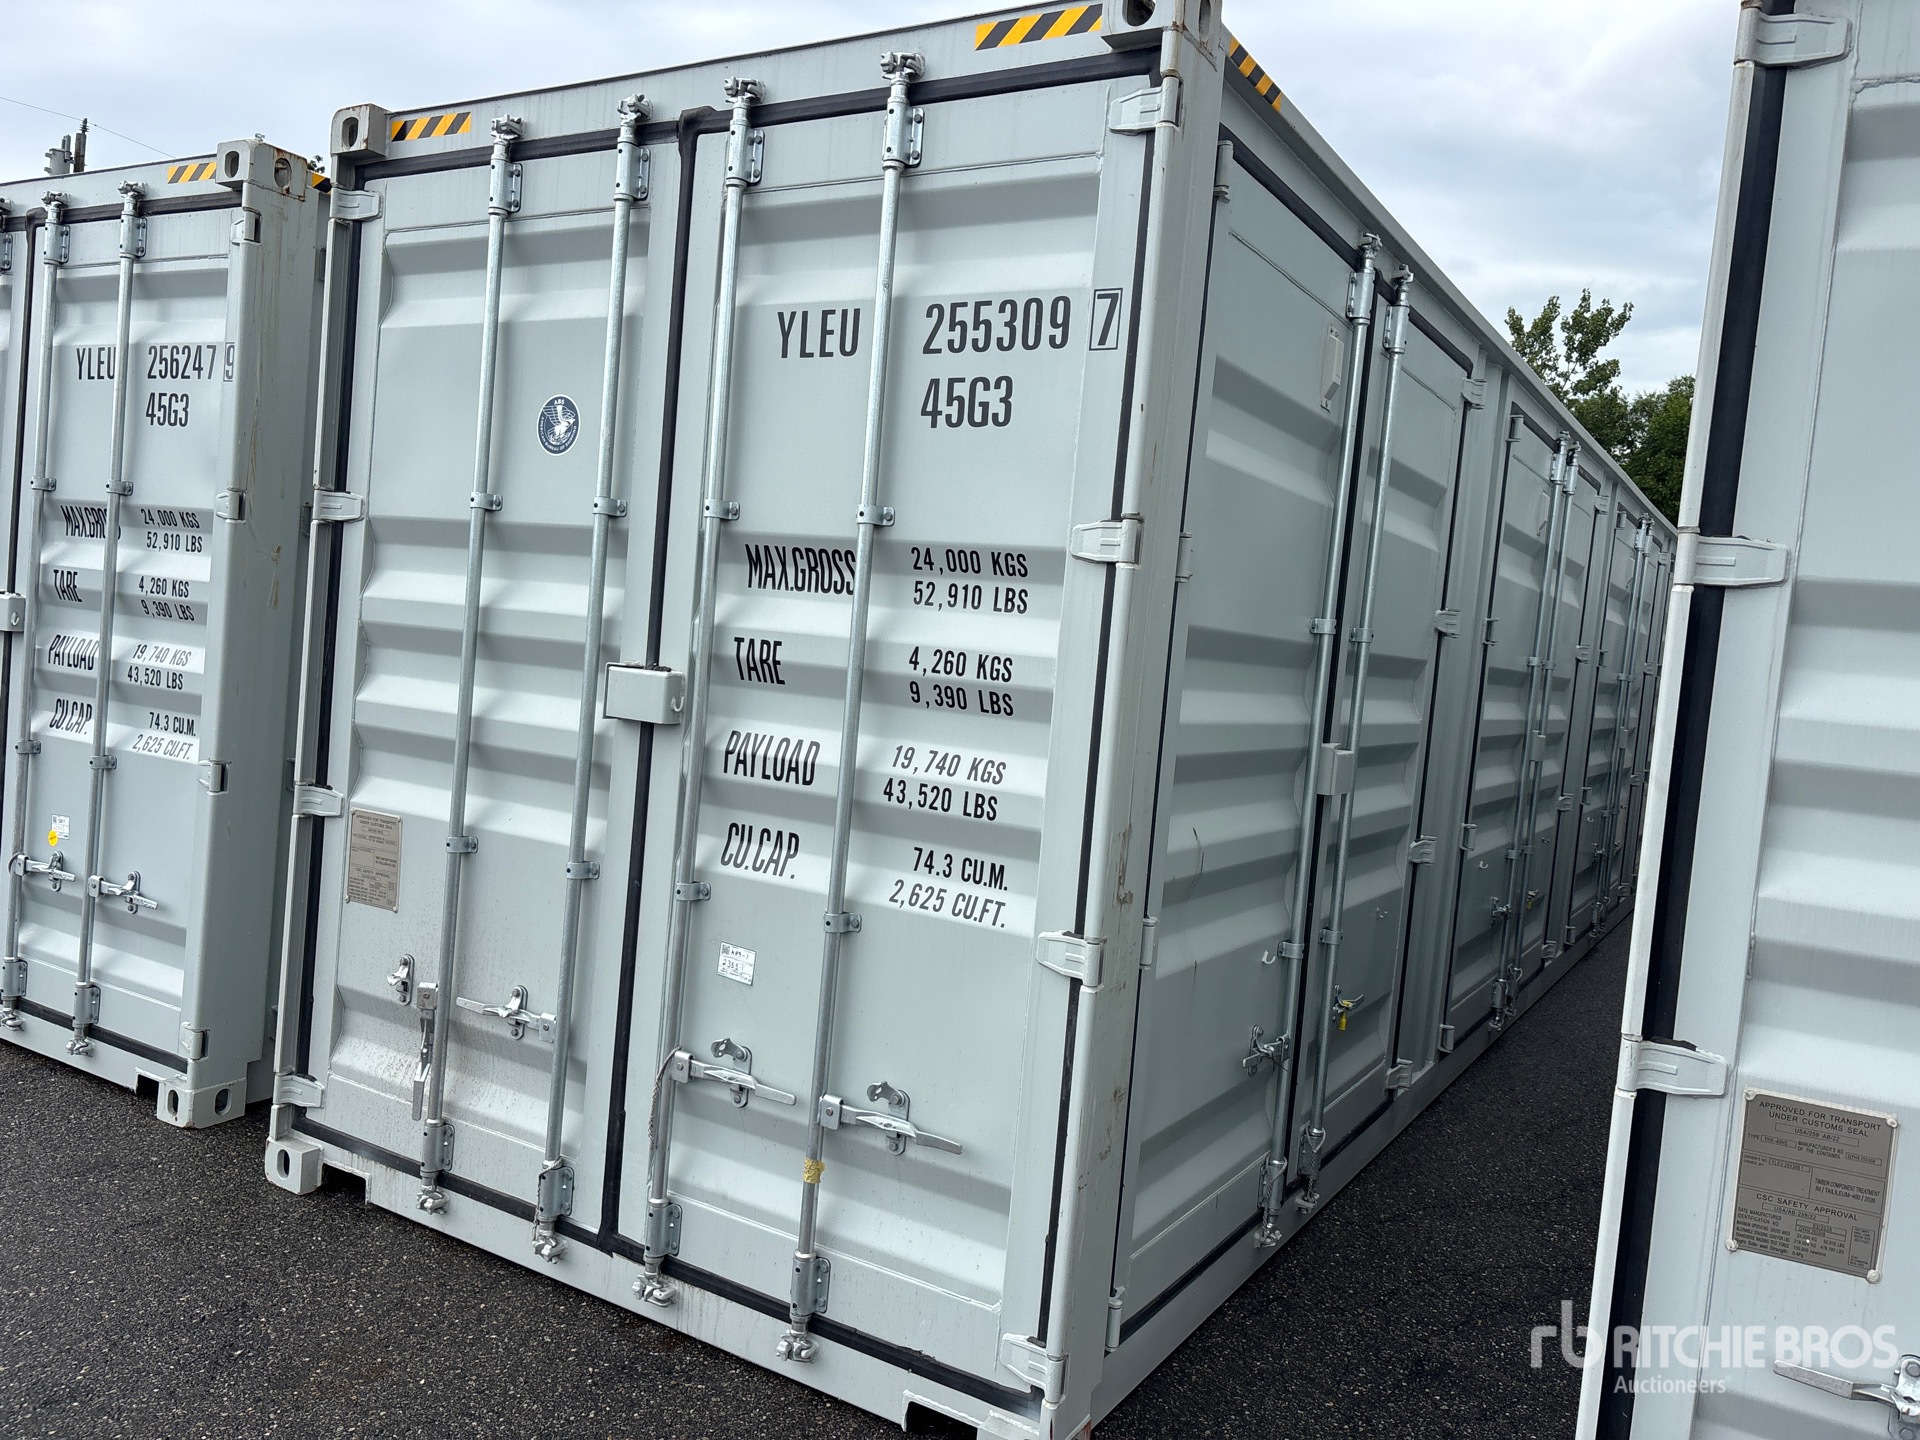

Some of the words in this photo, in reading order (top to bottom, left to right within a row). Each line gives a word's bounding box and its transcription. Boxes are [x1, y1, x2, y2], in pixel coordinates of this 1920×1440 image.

[777, 308, 861, 358] YLEU
[922, 295, 1071, 355] 255309
[1095, 292, 1120, 347] 7
[148, 345, 216, 380] 256247
[146, 392, 190, 427] 45G3
[920, 375, 1014, 429] 45G3
[141, 508, 178, 528] 24,000
[179, 511, 200, 529] KGS
[146, 532, 181, 552] 52,910
[185, 534, 203, 553] LBS
[53, 569, 83, 602] TARE
[139, 576, 167, 596] 4,260
[172, 580, 189, 598] KGS
[745, 544, 856, 595] MAX.GROSS
[910, 546, 982, 575] 24,000
[991, 552, 1029, 579] KGS
[141, 600, 173, 619] 9,390
[174, 603, 195, 621] LBS
[913, 581, 982, 612] 52,910
[993, 586, 1029, 614] LBS
[48, 634, 100, 671] PAYLOAD
[132, 643, 170, 663] 19,740
[169, 651, 192, 667] KGS
[734, 636, 786, 685] TARE
[908, 646, 967, 678] 4,260
[976, 654, 1013, 683] KGS
[127, 665, 161, 687] 43,520
[166, 671, 183, 690] LBS
[909, 681, 968, 710] 9,390
[978, 689, 1014, 716] LBS
[49, 698, 93, 735] CU.CAP.
[149, 712, 169, 731] 74.3
[173, 716, 196, 736] CU.M.
[132, 734, 165, 754] 2,625
[163, 739, 193, 760] CU.FT.
[723, 730, 821, 786] PAYLOAD
[892, 745, 961, 777] 19,740
[967, 757, 1007, 785] KGS
[883, 778, 951, 812] 43,520
[963, 790, 998, 821] LBS
[720, 822, 800, 879] CU.CAP.
[913, 847, 953, 878] 74.3
[961, 858, 1008, 891] CU.M.
[889, 879, 947, 912] 2,625
[951, 893, 1006, 928] CU.FT.
[1759, 1101, 1805, 1116] APPROVED
[1808, 1110, 1826, 1120] FOR
[1829, 1114, 1882, 1131] TRANSPORT
[1769, 1111, 1798, 1122] UNDER
[1802, 1117, 1843, 1132] CUSTOMS
[1847, 1127, 1869, 1137] SEAL
[1794, 1128, 1819, 1138] USA/259
[1815, 1177, 1829, 1186] TIMBER
[1830, 1181, 1855, 1192] COMPONENT
[1856, 1186, 1880, 1197] TREATMENT
[1738, 1213, 1770, 1224] IDENTIFICATION
[1750, 1209, 1782, 1221] MANUFACTURED
[1756, 1193, 1773, 1202] CSC
[1777, 1198, 1809, 1210] SAFETY
[1814, 1206, 1858, 1221] APPROVAL
